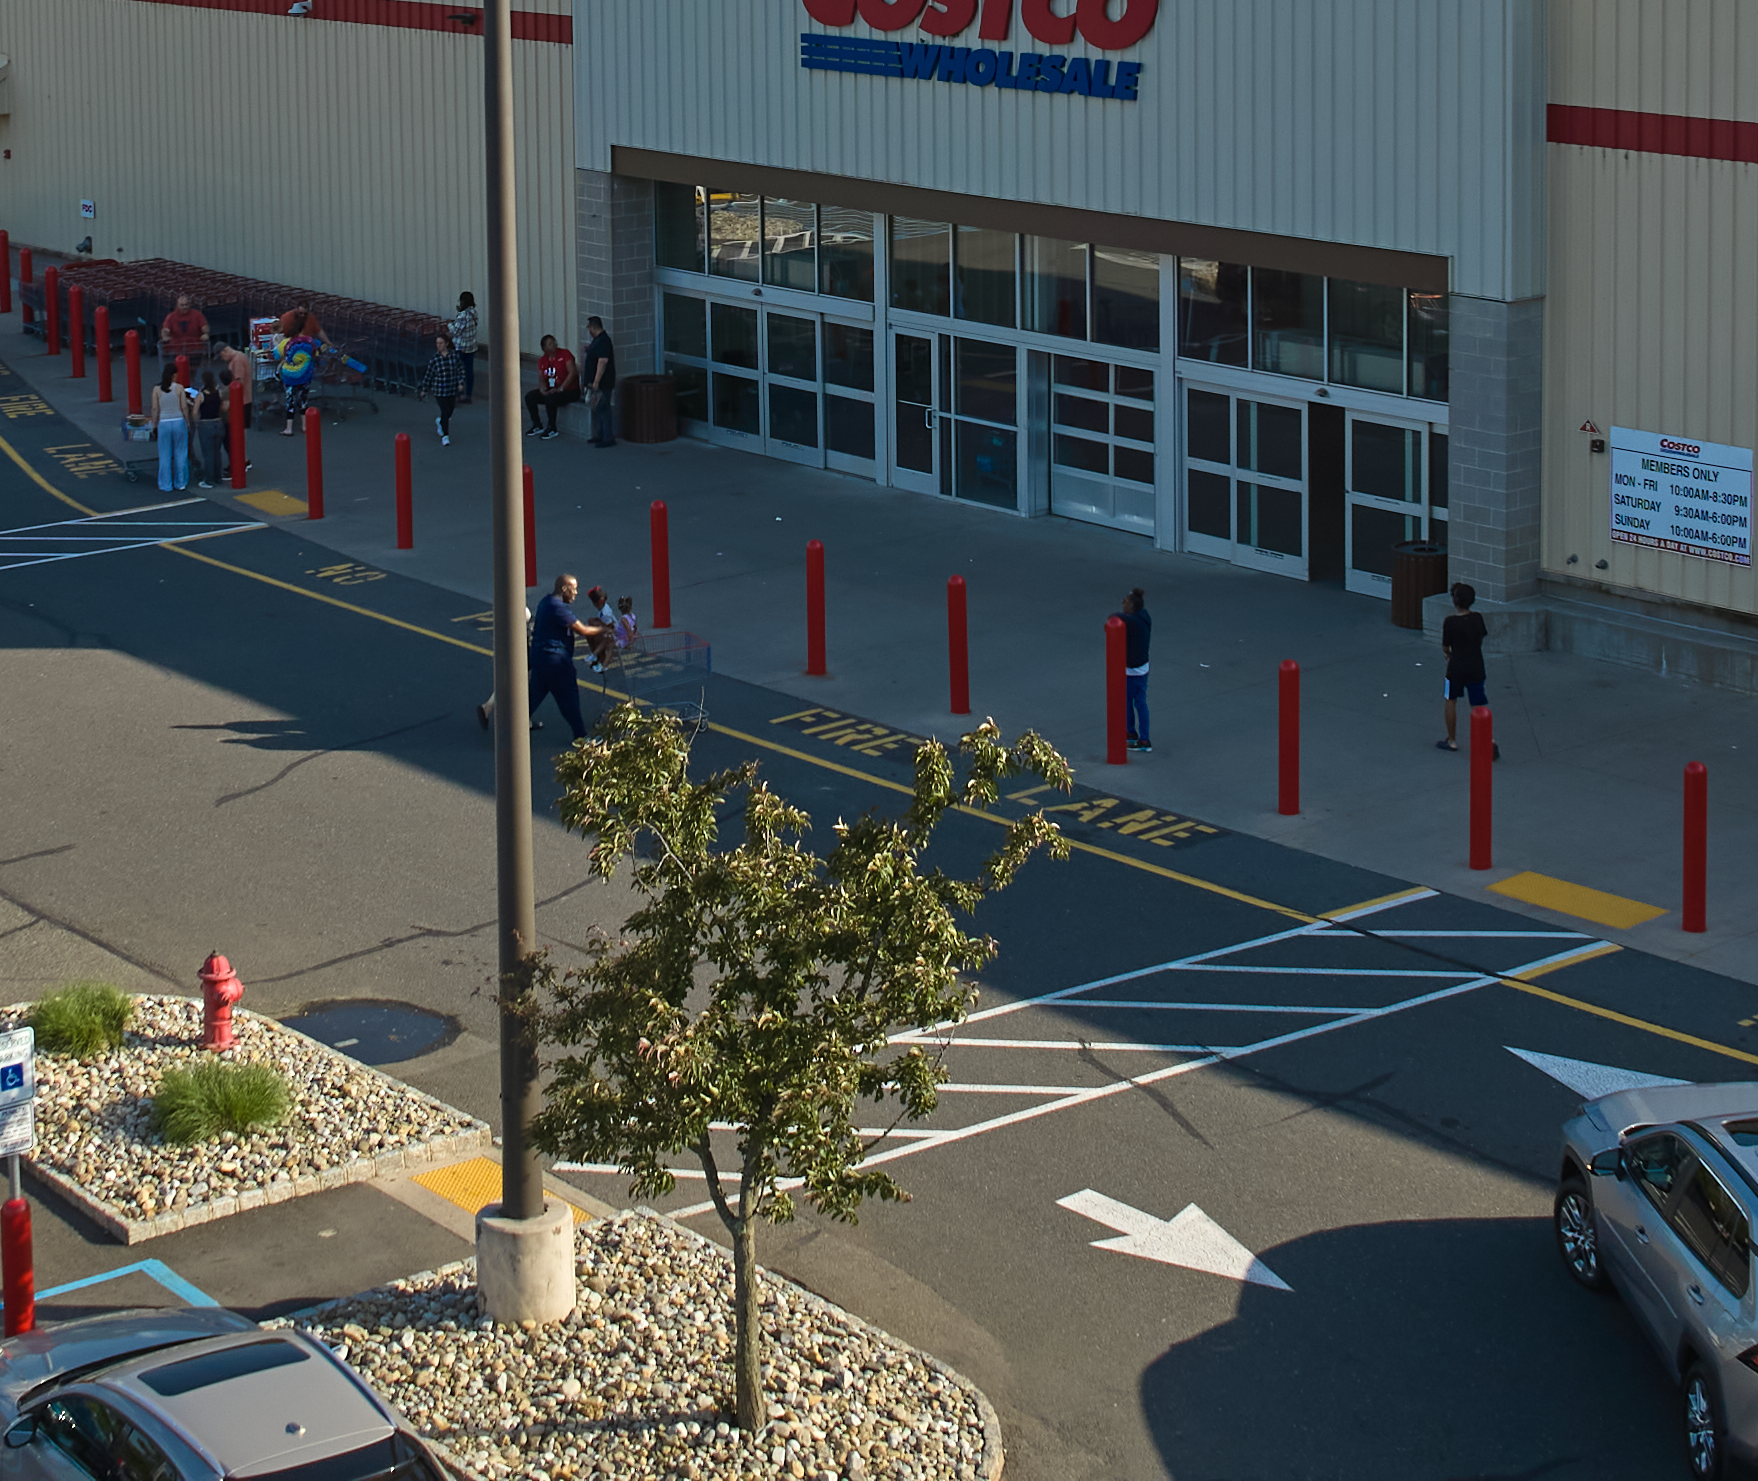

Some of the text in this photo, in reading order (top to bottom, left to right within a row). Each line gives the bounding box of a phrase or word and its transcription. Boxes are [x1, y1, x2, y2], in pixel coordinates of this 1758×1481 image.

[899, 41, 1142, 100] WHOLESALE
[1659, 438, 1701, 454] COSTCO
[1641, 458, 1720, 482] MEMBERS ONLY
[1614, 473, 1636, 488] MON
[1643, 478, 1659, 492] FRI
[1614, 493, 1662, 513] SATURDAY
[1614, 513, 1651, 531] SUNDAY
[1666, 540, 1679, 551] DAY
[769, 708, 930, 757] FIRE
[1004, 784, 1222, 847] LANE
